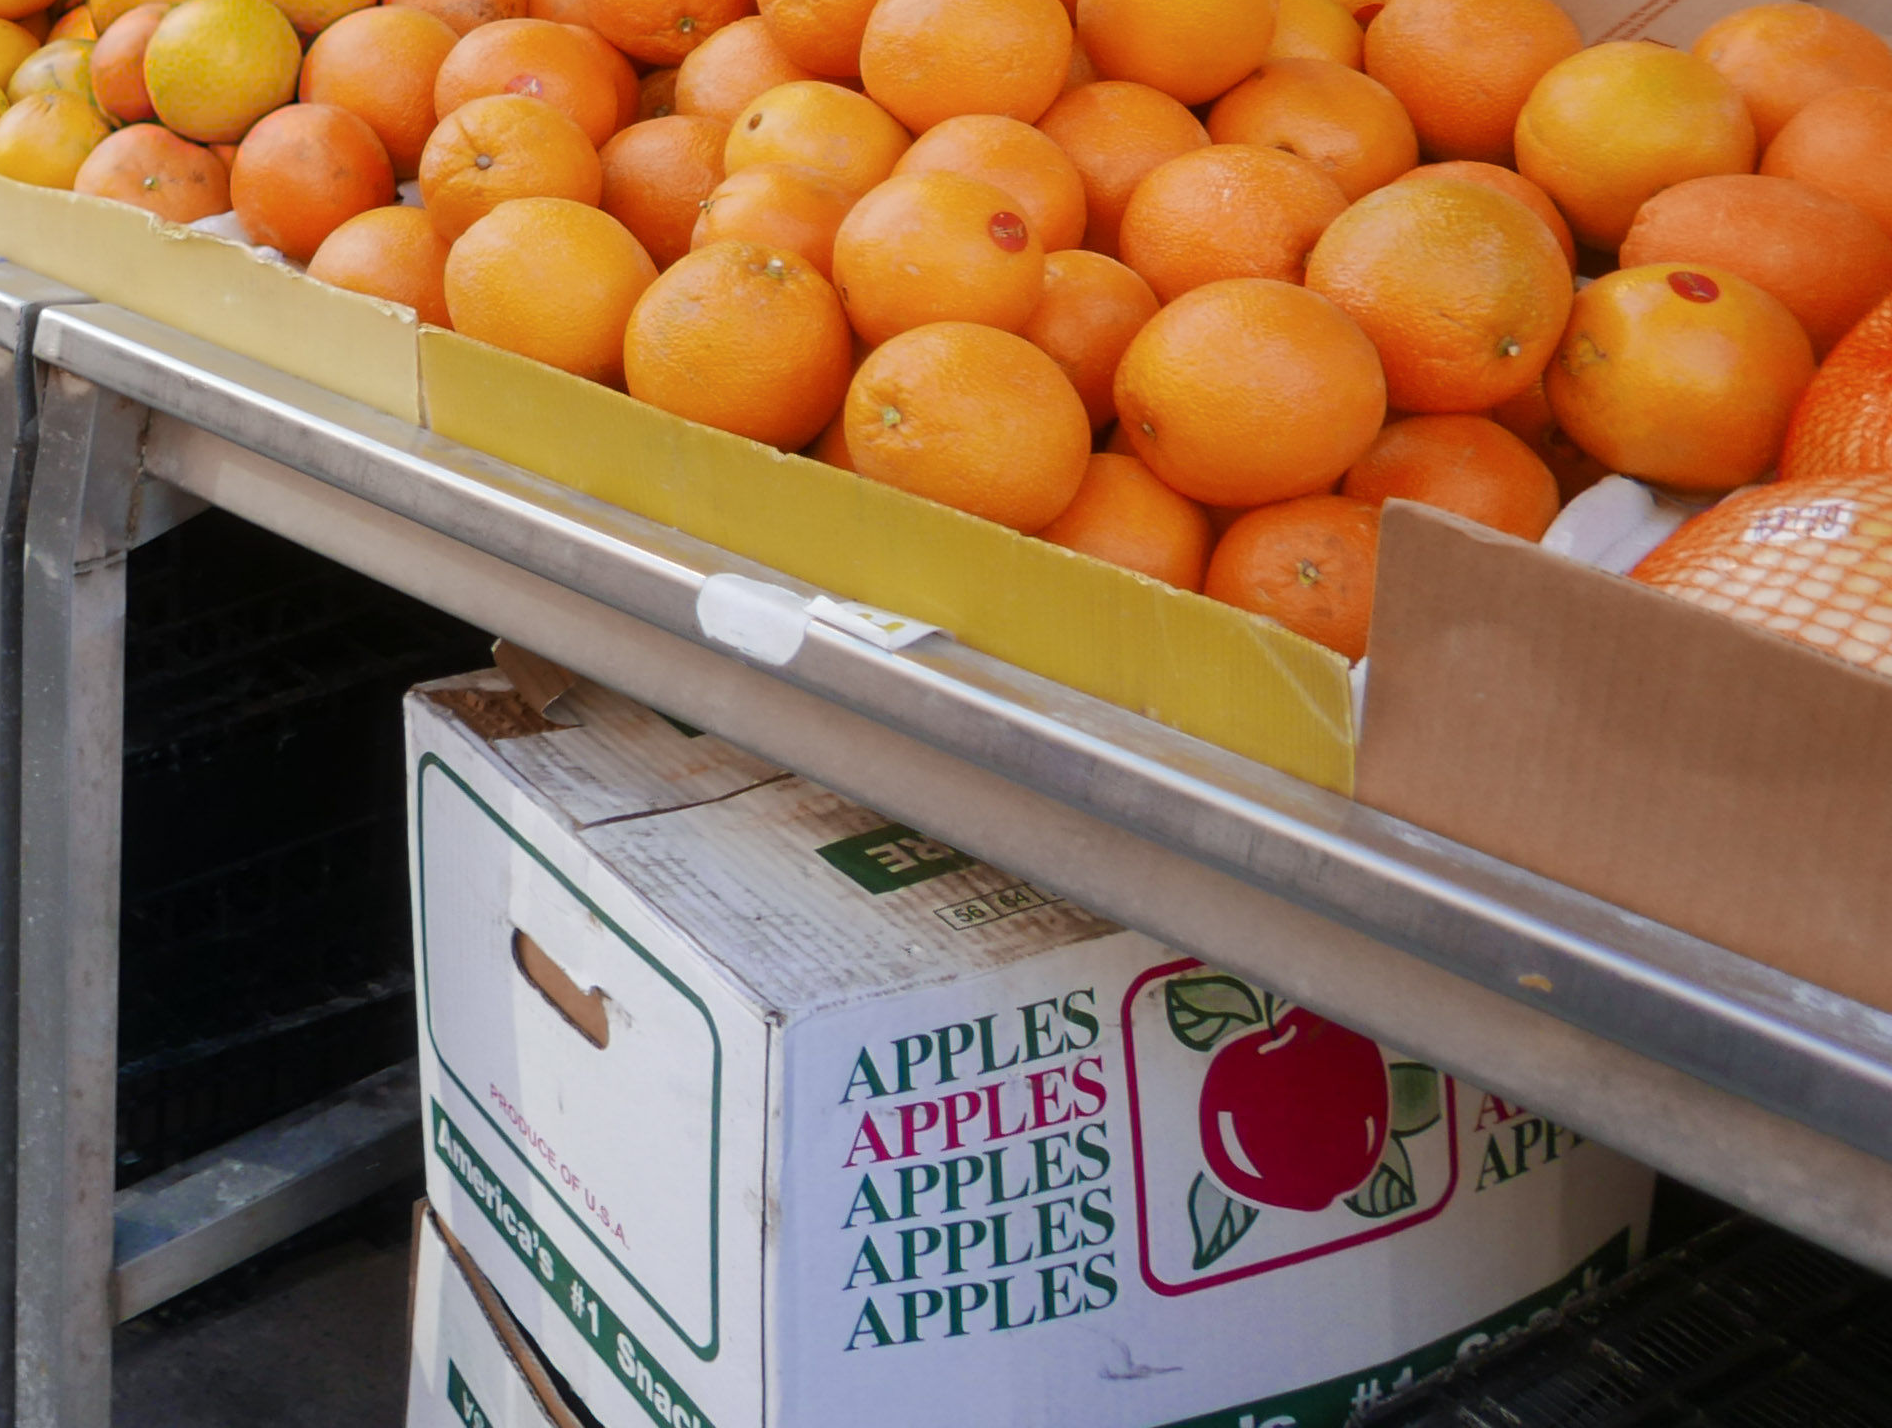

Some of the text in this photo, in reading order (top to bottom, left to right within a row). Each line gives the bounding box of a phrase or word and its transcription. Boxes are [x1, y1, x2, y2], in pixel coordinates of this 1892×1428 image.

[865, 834, 955, 873] RE
[997, 890, 1032, 908] 64
[954, 904, 987, 923] 56
[839, 987, 1099, 1105] APPLES
[490, 1082, 557, 1170] PRODUCE
[560, 1164, 581, 1192] OF
[841, 1055, 1107, 1168] APPLES
[437, 1118, 555, 1281] America's
[569, 1279, 600, 1337] #1
[841, 1121, 1111, 1229] APPLES
[842, 1186, 1115, 1291] APPLES
[843, 1251, 1118, 1352] APPLES
